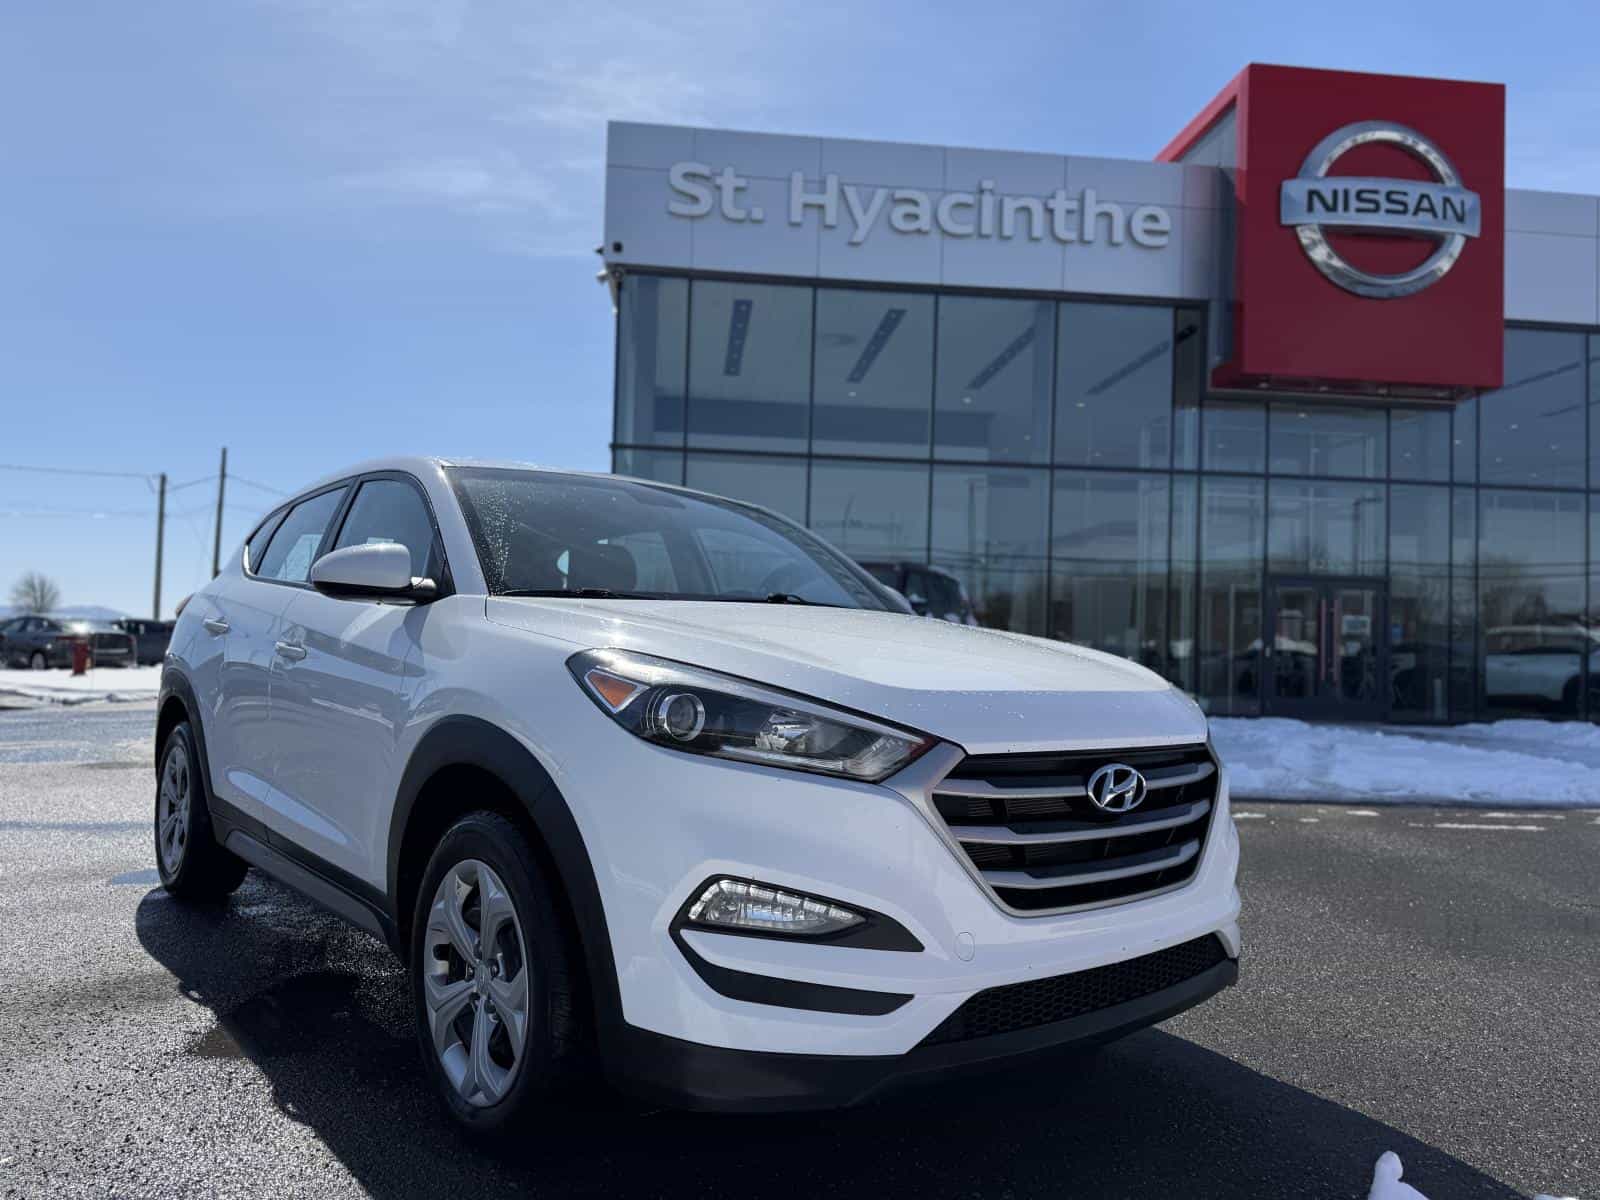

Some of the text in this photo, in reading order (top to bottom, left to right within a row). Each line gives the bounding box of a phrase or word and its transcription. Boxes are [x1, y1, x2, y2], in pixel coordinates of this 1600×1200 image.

[667, 160, 1171, 247] St. Hyacinthe
[1306, 188, 1466, 223] NISSAN
